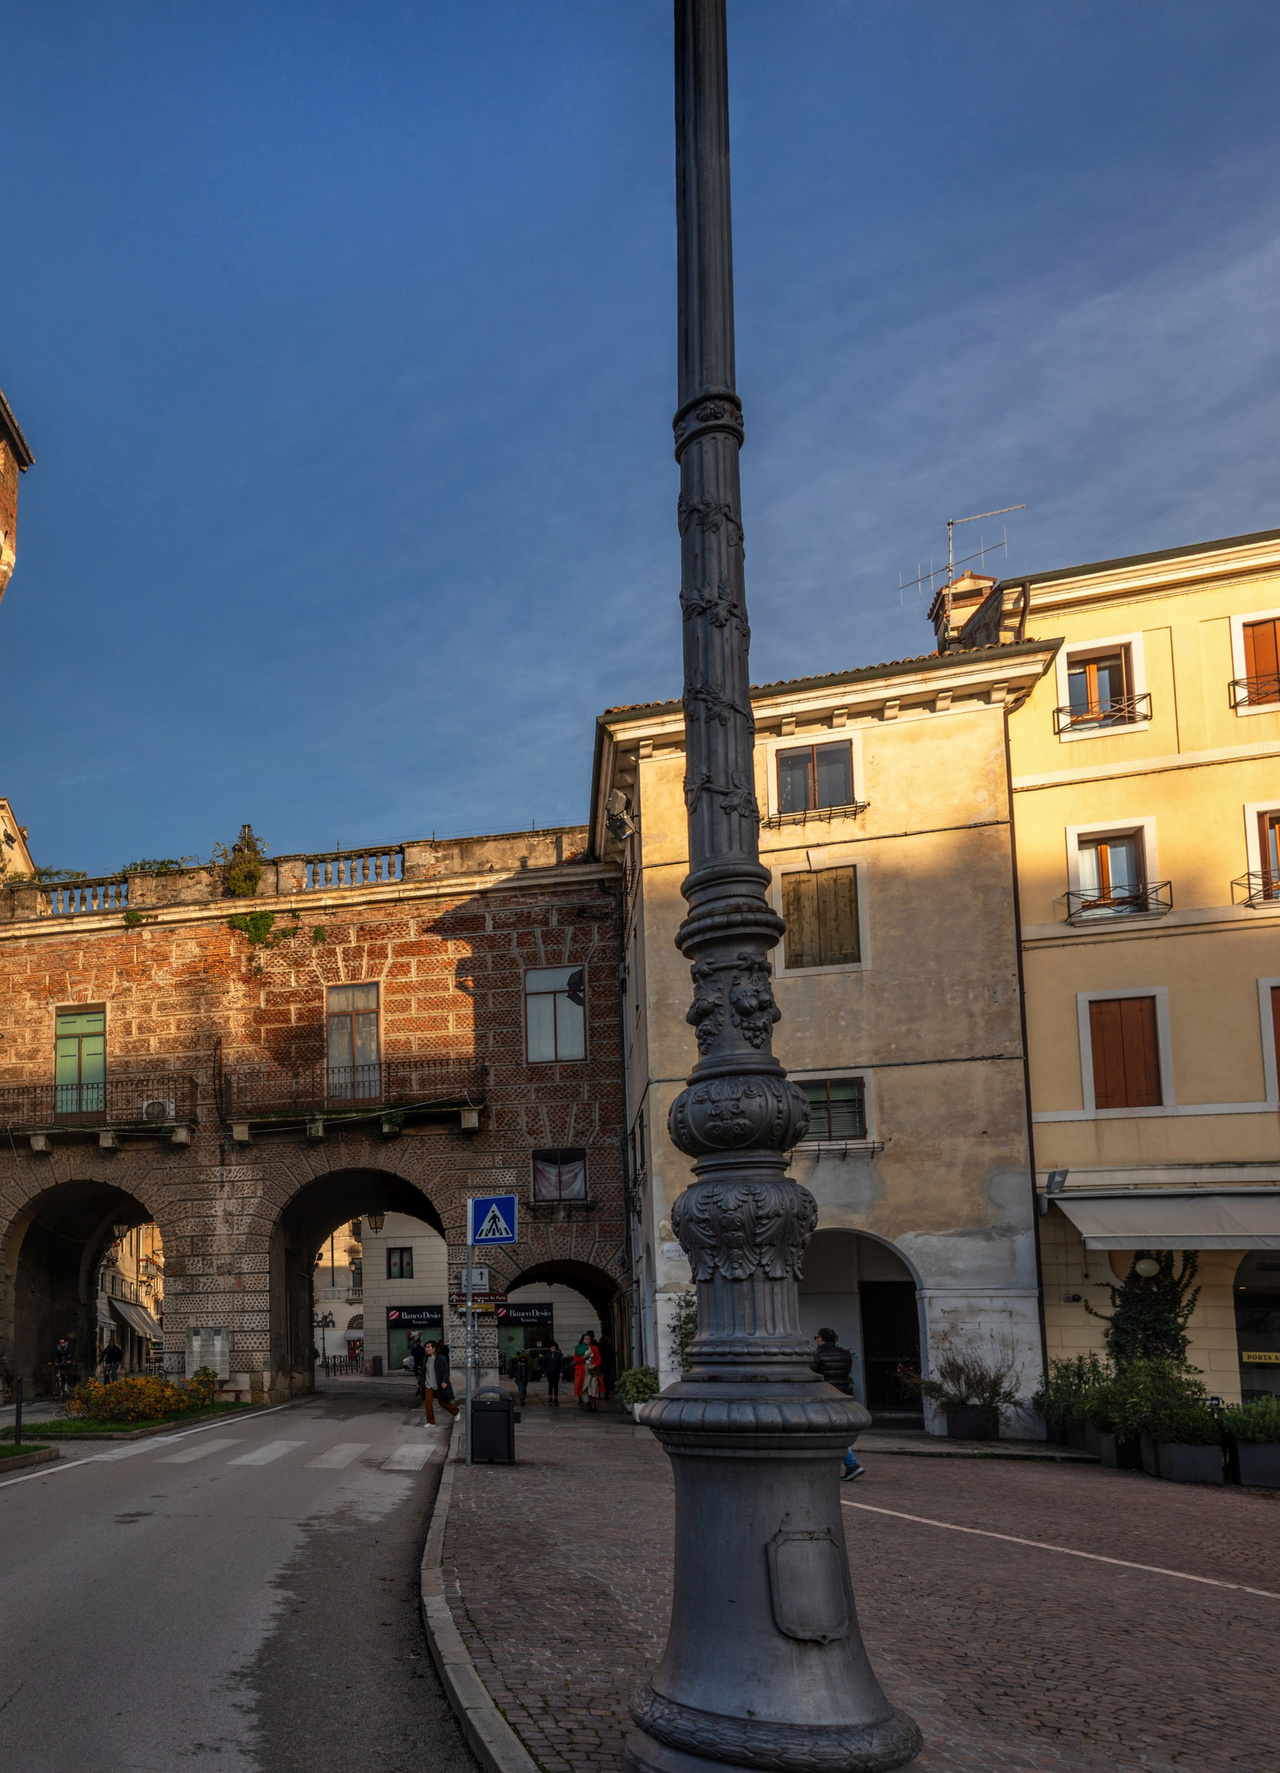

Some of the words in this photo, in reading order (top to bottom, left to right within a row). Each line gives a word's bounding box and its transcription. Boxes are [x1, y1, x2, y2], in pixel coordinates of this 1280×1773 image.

[422, 1311, 441, 1319] Desio
[509, 1309, 531, 1317] Banco
[531, 1309, 551, 1317] Desio
